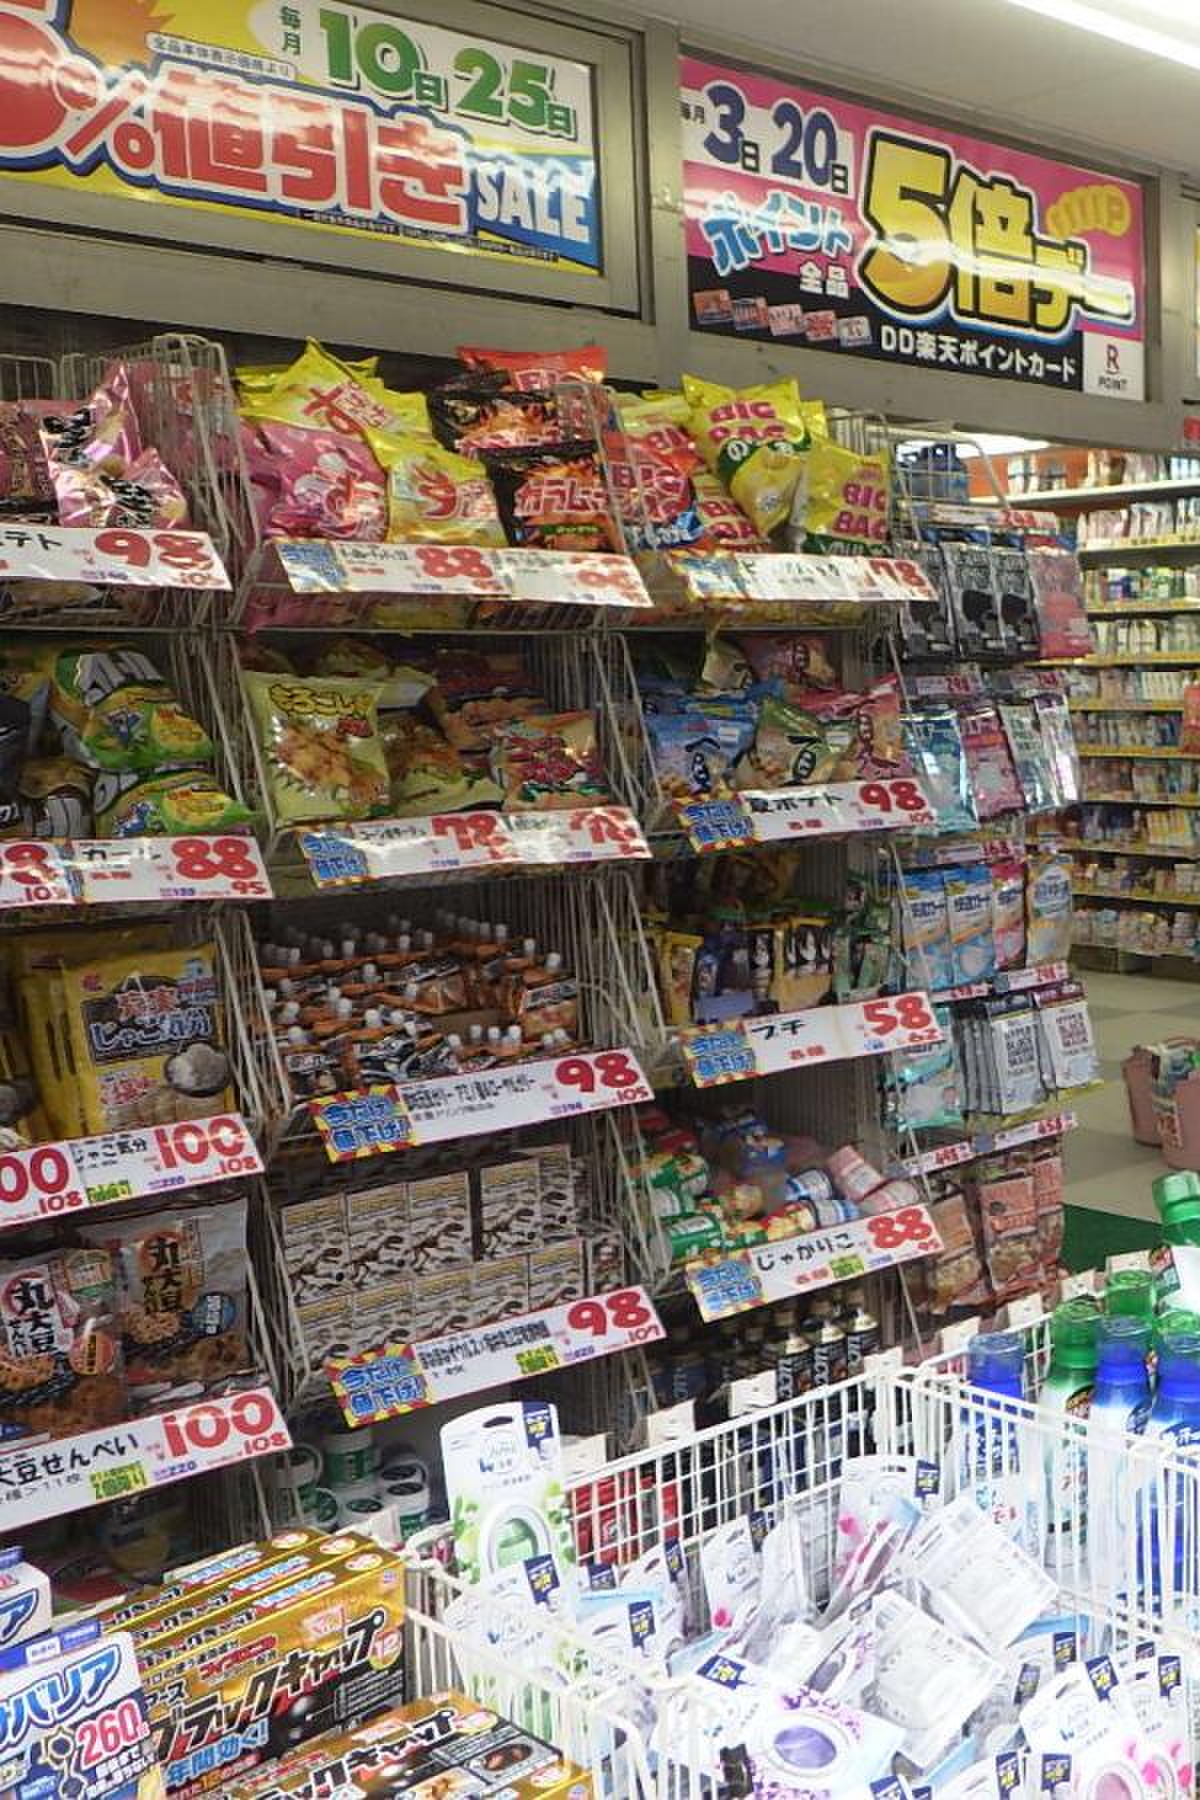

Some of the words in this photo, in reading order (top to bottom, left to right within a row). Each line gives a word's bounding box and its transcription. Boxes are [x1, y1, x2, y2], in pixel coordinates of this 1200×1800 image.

[281, 4, 301, 54] 毎月
[475, 158, 590, 243] SALE
[702, 193, 854, 276] ポイント
[857, 129, 1136, 333] 5倍デー
[799, 261, 850, 299] 全品
[880, 325, 1077, 382] DD楽天ポイントカード
[0, 530, 63, 550] テト
[95, 530, 215, 571] 98
[858, 780, 928, 813] 98
[0, 842, 57, 886] 8
[171, 838, 258, 880] 88
[231, 880, 267, 896] 95
[751, 1019, 806, 1041] プチ
[862, 998, 932, 1037] 58
[908, 1028, 939, 1042] 62
[554, 1052, 640, 1093] 98
[614, 1086, 649, 1104] 105
[153, 1116, 249, 1169] 100
[219, 1157, 258, 1174] 108
[38, 1191, 84, 1214] 108
[757, 1230, 855, 1272] じゃがりこ
[865, 1204, 934, 1250] 88
[567, 1290, 651, 1339] 98
[628, 1323, 660, 1343] 107
[160, 1392, 275, 1458] 100
[244, 1433, 290, 1456] 108
[150, 1605, 387, 1762] ブラックキャップ
